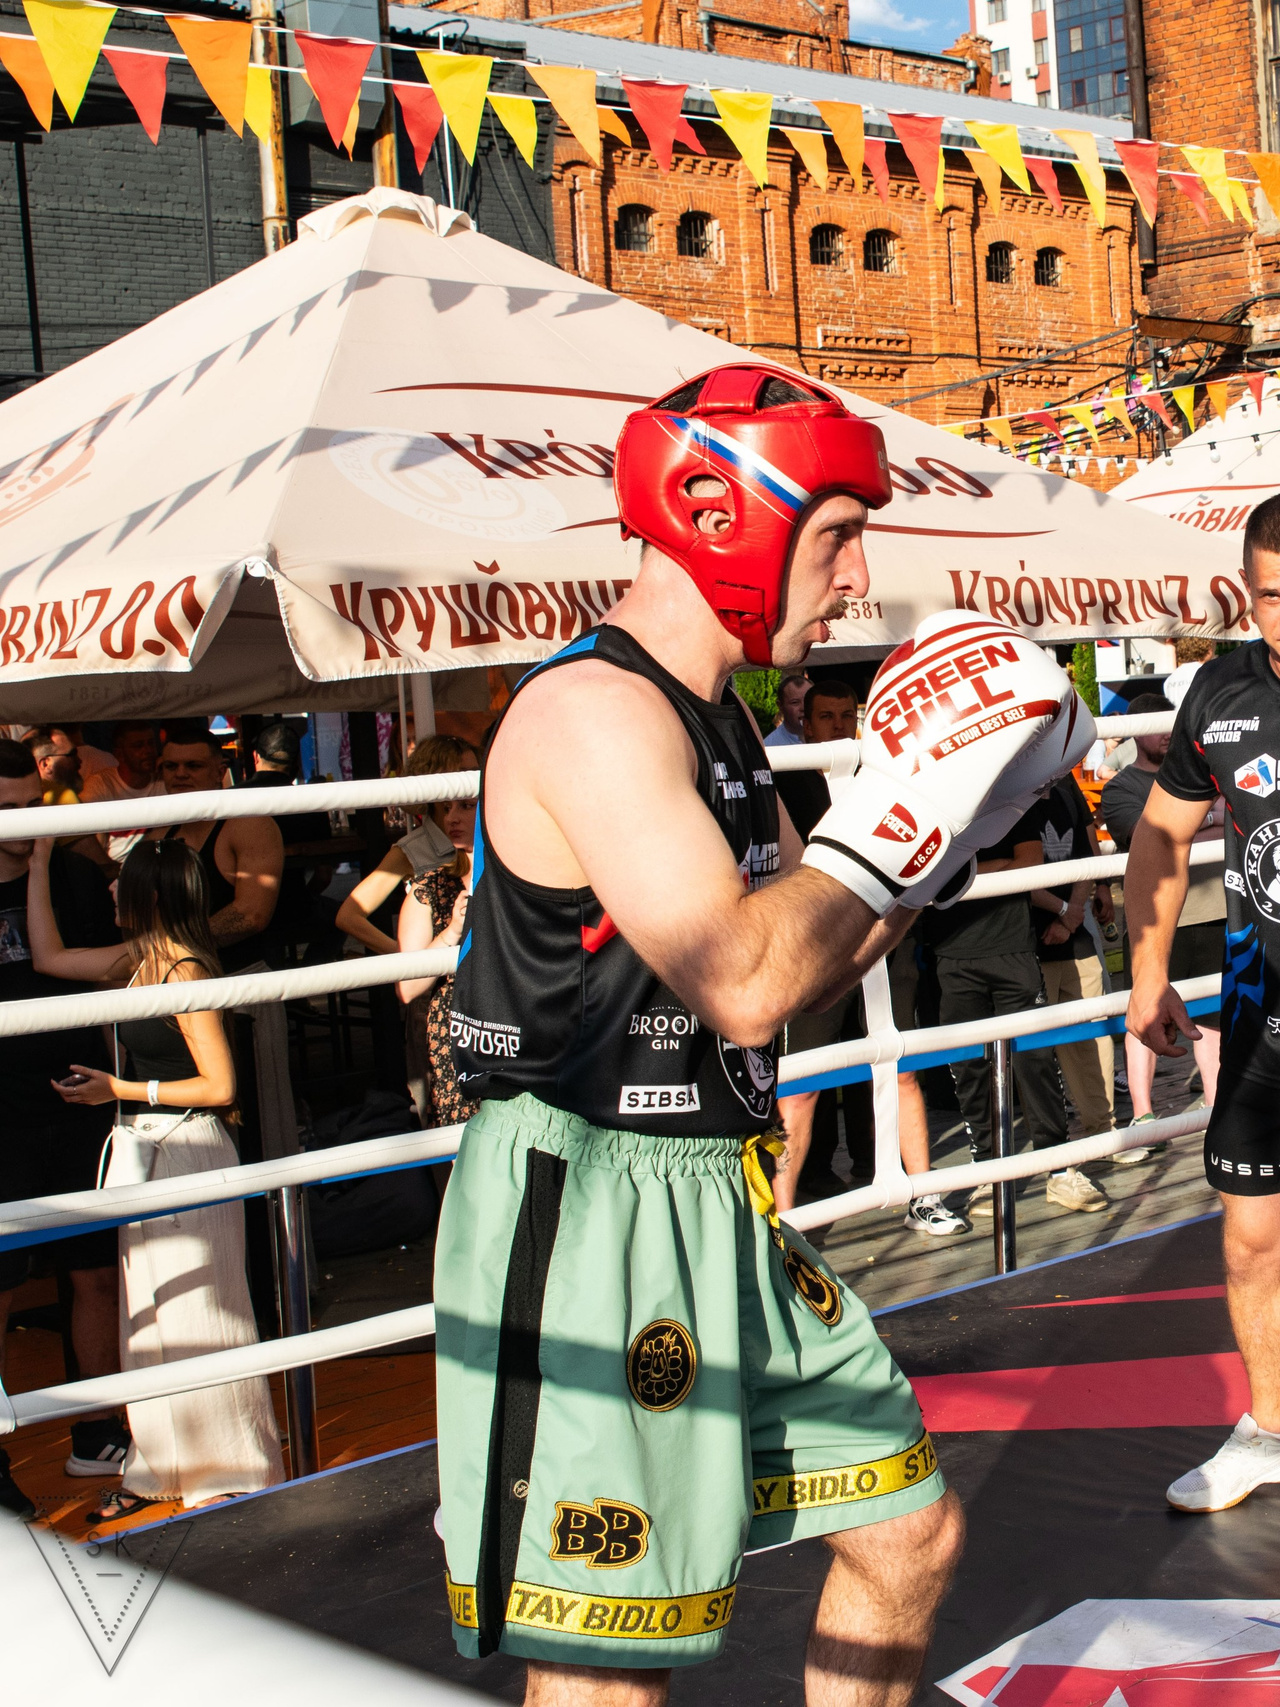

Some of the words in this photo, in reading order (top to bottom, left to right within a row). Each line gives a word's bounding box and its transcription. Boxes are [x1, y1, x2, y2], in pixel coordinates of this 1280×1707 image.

[870, 641, 1021, 732] GREEN
[879, 675, 1016, 759] HILL
[939, 738, 956, 755] BE
[953, 726, 982, 747] YOUR
[978, 714, 1006, 734] BEST
[1003, 705, 1027, 723] SELF
[651, 1039, 680, 1050] GIN
[786, 1468, 879, 1506] BIDLO
[514, 1588, 581, 1626] TAY
[582, 1602, 683, 1634] BIDLO
